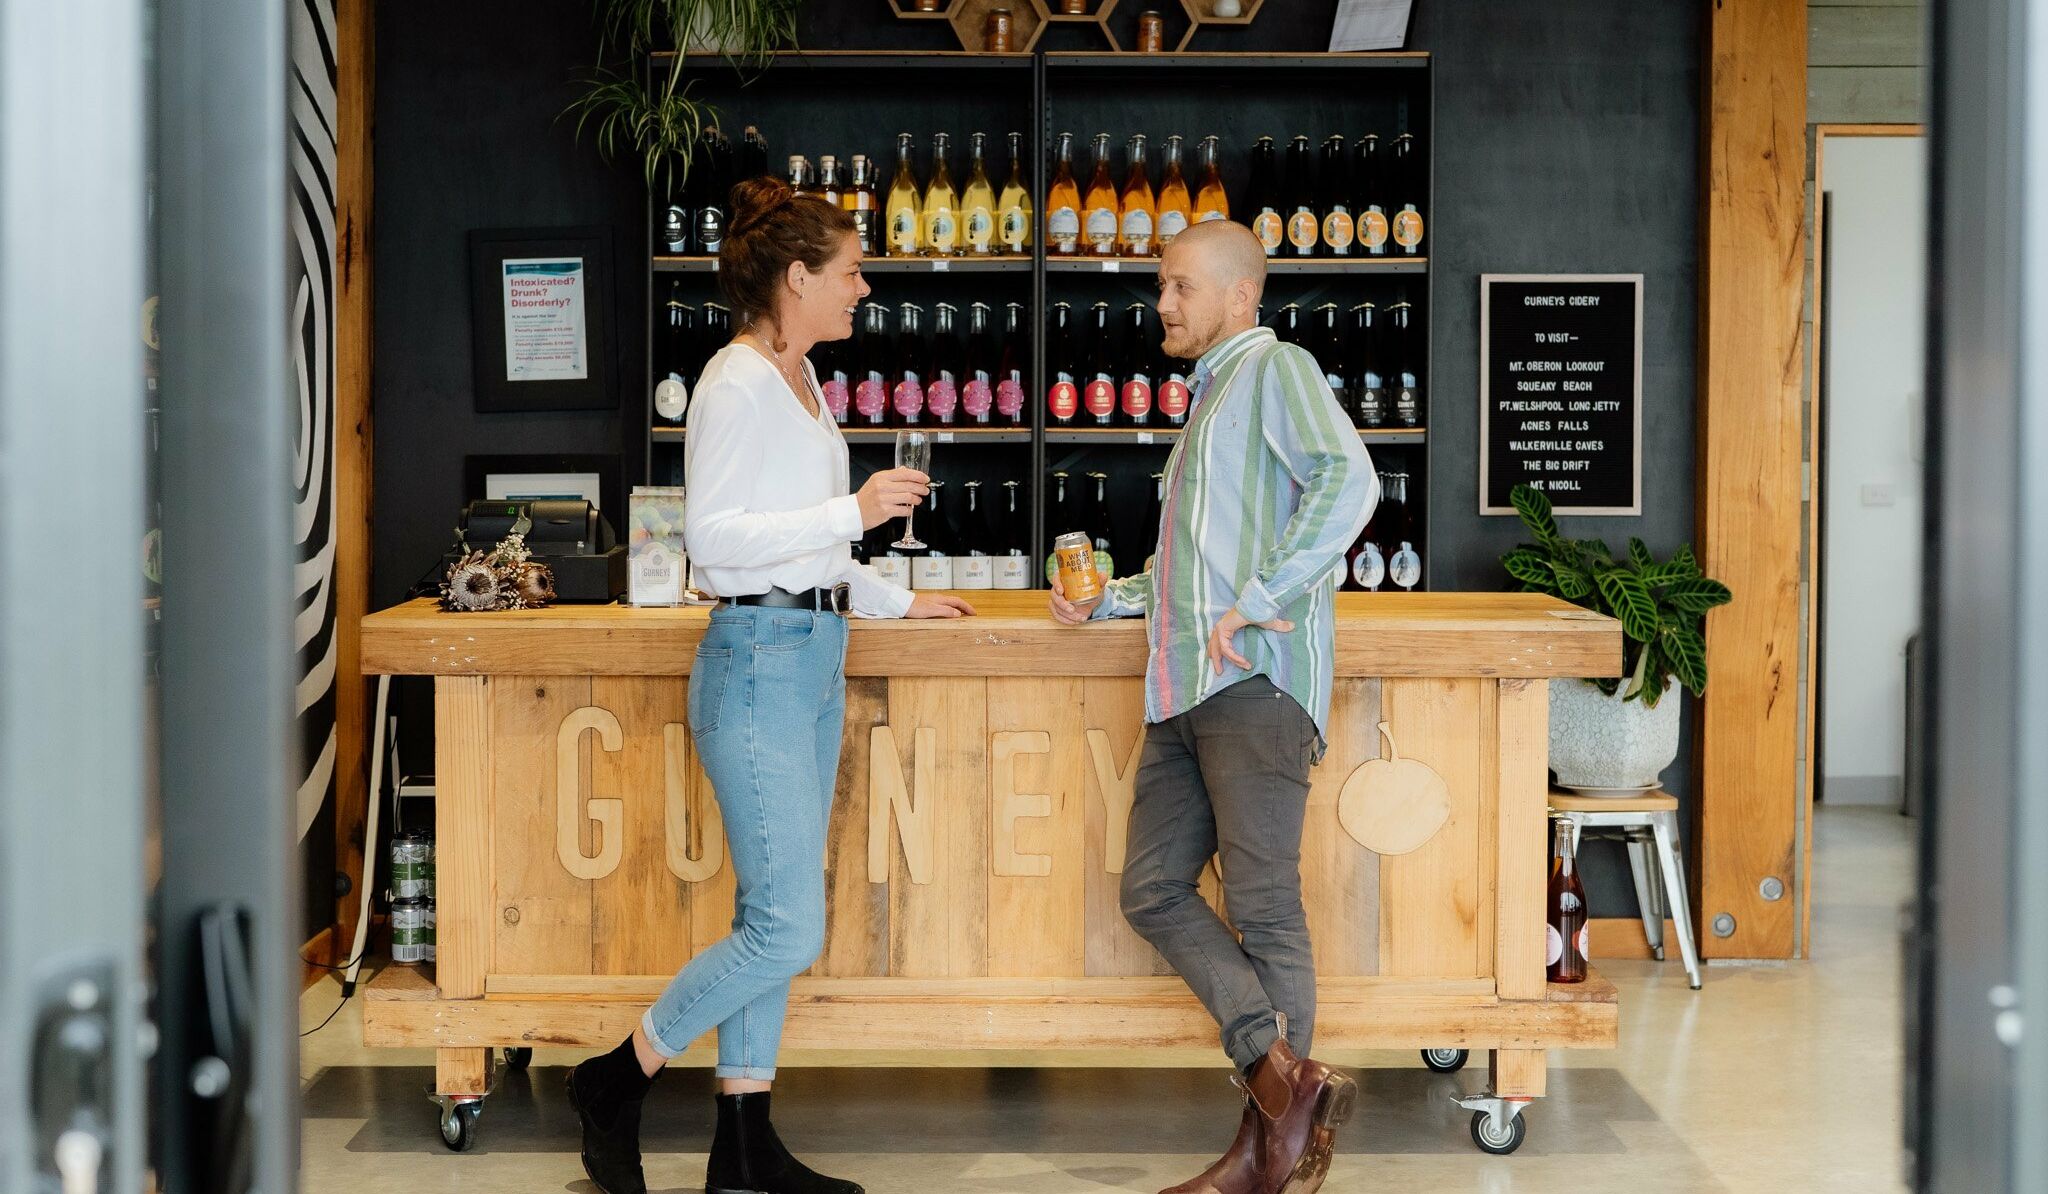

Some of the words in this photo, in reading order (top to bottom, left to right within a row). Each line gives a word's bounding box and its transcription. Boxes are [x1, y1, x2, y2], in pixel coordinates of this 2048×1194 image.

[511, 277, 575, 286] Intoxicated?
[511, 288, 548, 297] Drunk?
[511, 298, 571, 308] Disorderly?
[1569, 296, 1600, 306] CIDERY
[1534, 332, 1546, 343] TO
[1509, 361, 1524, 372] MT.
[1527, 361, 1562, 372] OBERON
[1566, 361, 1604, 372] LOOKOUT
[1517, 381, 1556, 391] SQUEAKY
[1563, 381, 1593, 391] BEACH
[1592, 401, 1620, 411] JETTY
[1558, 421, 1589, 431] FALLS
[1509, 441, 1572, 451] WALKERVILLE
[1575, 441, 1604, 451] CAVES
[1523, 461, 1542, 471] THE
[1562, 461, 1590, 471] DRIFT
[1530, 480, 1544, 490] MT.
[1548, 480, 1581, 490] NICOLL
[1068, 549, 1089, 560] WHAT
[1066, 556, 1090, 567] ABOUT
[556, 706, 1222, 883] GUNEY
